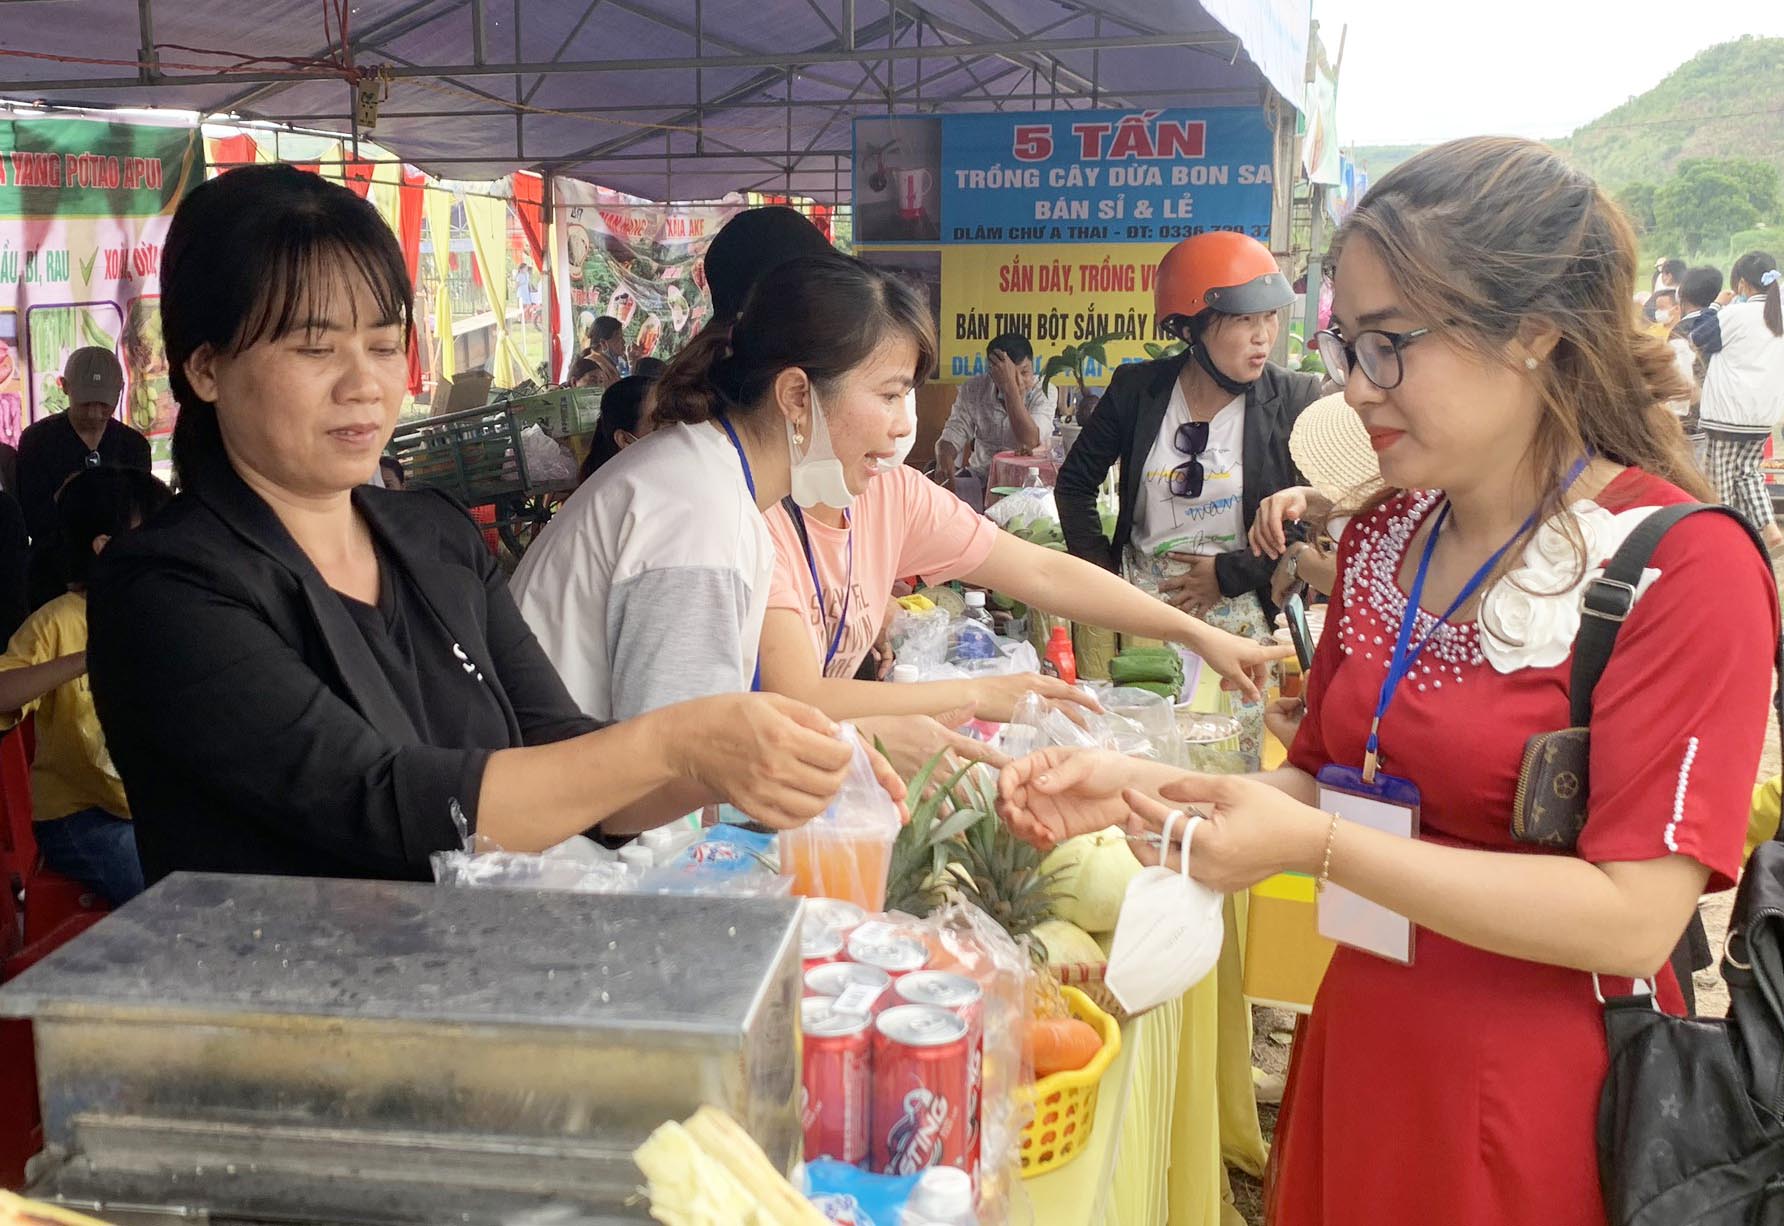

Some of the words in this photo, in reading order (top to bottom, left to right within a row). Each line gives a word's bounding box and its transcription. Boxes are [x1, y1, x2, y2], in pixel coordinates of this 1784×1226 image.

[1013, 124, 1054, 162] 5
[1071, 108, 1207, 161] TẤN
[10, 151, 61, 188] YANG
[123, 156, 163, 190] APUI
[1049, 164, 1100, 188] CÂY
[1172, 165, 1229, 187] BON
[1034, 197, 1089, 220] BÁN
[1098, 193, 1125, 220] SỈ
[1133, 199, 1153, 219] &
[1163, 192, 1193, 219] LẺ
[1051, 226, 1061, 240] A
[1067, 225, 1108, 240] THAI
[46, 250, 70, 282] RAU
[999, 254, 1034, 292] SẮN
[1039, 258, 1074, 295] DÂY,
[955, 307, 989, 340] BÁN
[1037, 307, 1069, 347] BỘT
[1073, 302, 1109, 340] SẮN
[1114, 307, 1147, 340] DÂY
[952, 352, 988, 377] DLÂ
